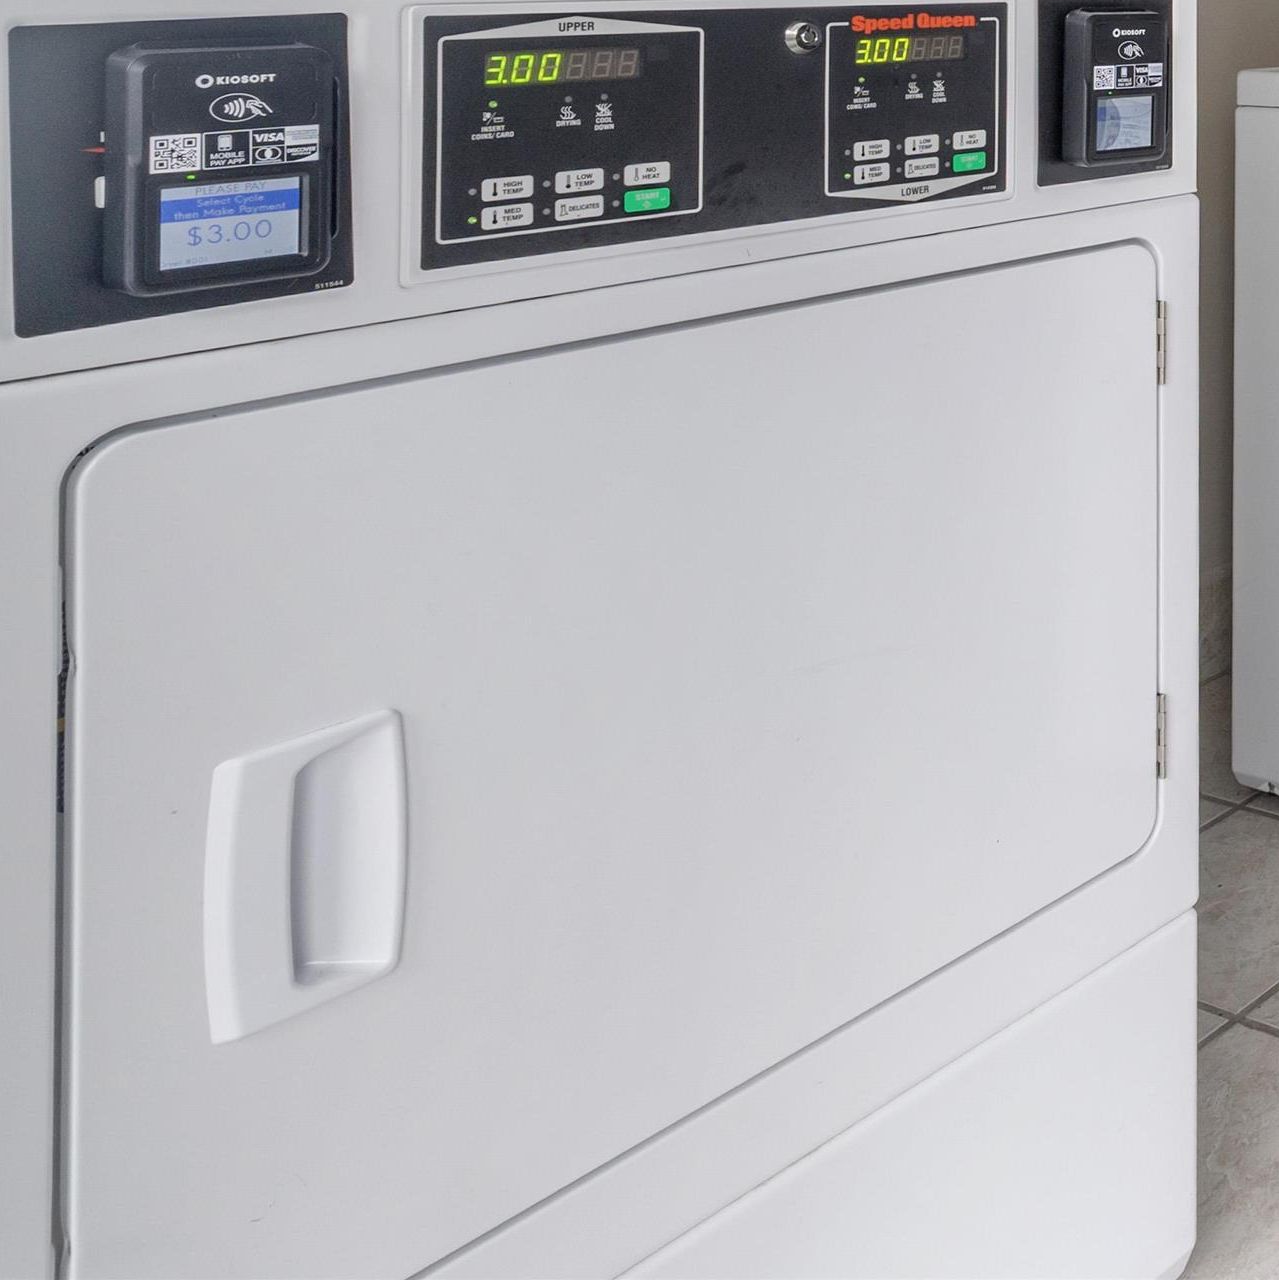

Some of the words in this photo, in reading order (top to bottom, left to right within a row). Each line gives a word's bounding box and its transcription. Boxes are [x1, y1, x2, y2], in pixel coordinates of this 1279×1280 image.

[558, 21, 595, 32] UPPER
[851, 14, 914, 34] Speed
[917, 12, 976, 28] Queen
[856, 38, 909, 63] 3.00
[485, 53, 562, 85] 3.00
[216, 73, 276, 85] KIOSOFT
[556, 119, 581, 127] DRYING
[594, 123, 615, 131] DOWN
[253, 132, 284, 143] VISA
[210, 151, 245, 160] MOBILE
[210, 159, 226, 167] PAY
[228, 158, 246, 166] APP
[642, 172, 660, 180] HEAT
[195, 185, 242, 196] PLEASE
[248, 181, 267, 191] PAY
[503, 180, 523, 188] HIGH
[901, 185, 929, 197] LOWER
[197, 197, 230, 207] Select
[234, 194, 264, 205] Cycle
[174, 211, 199, 220] then
[203, 208, 235, 217] Make
[239, 202, 286, 214] Payment
[504, 207, 522, 215] MED
[568, 202, 600, 212] DELICATES
[187, 219, 272, 246] $3.00
